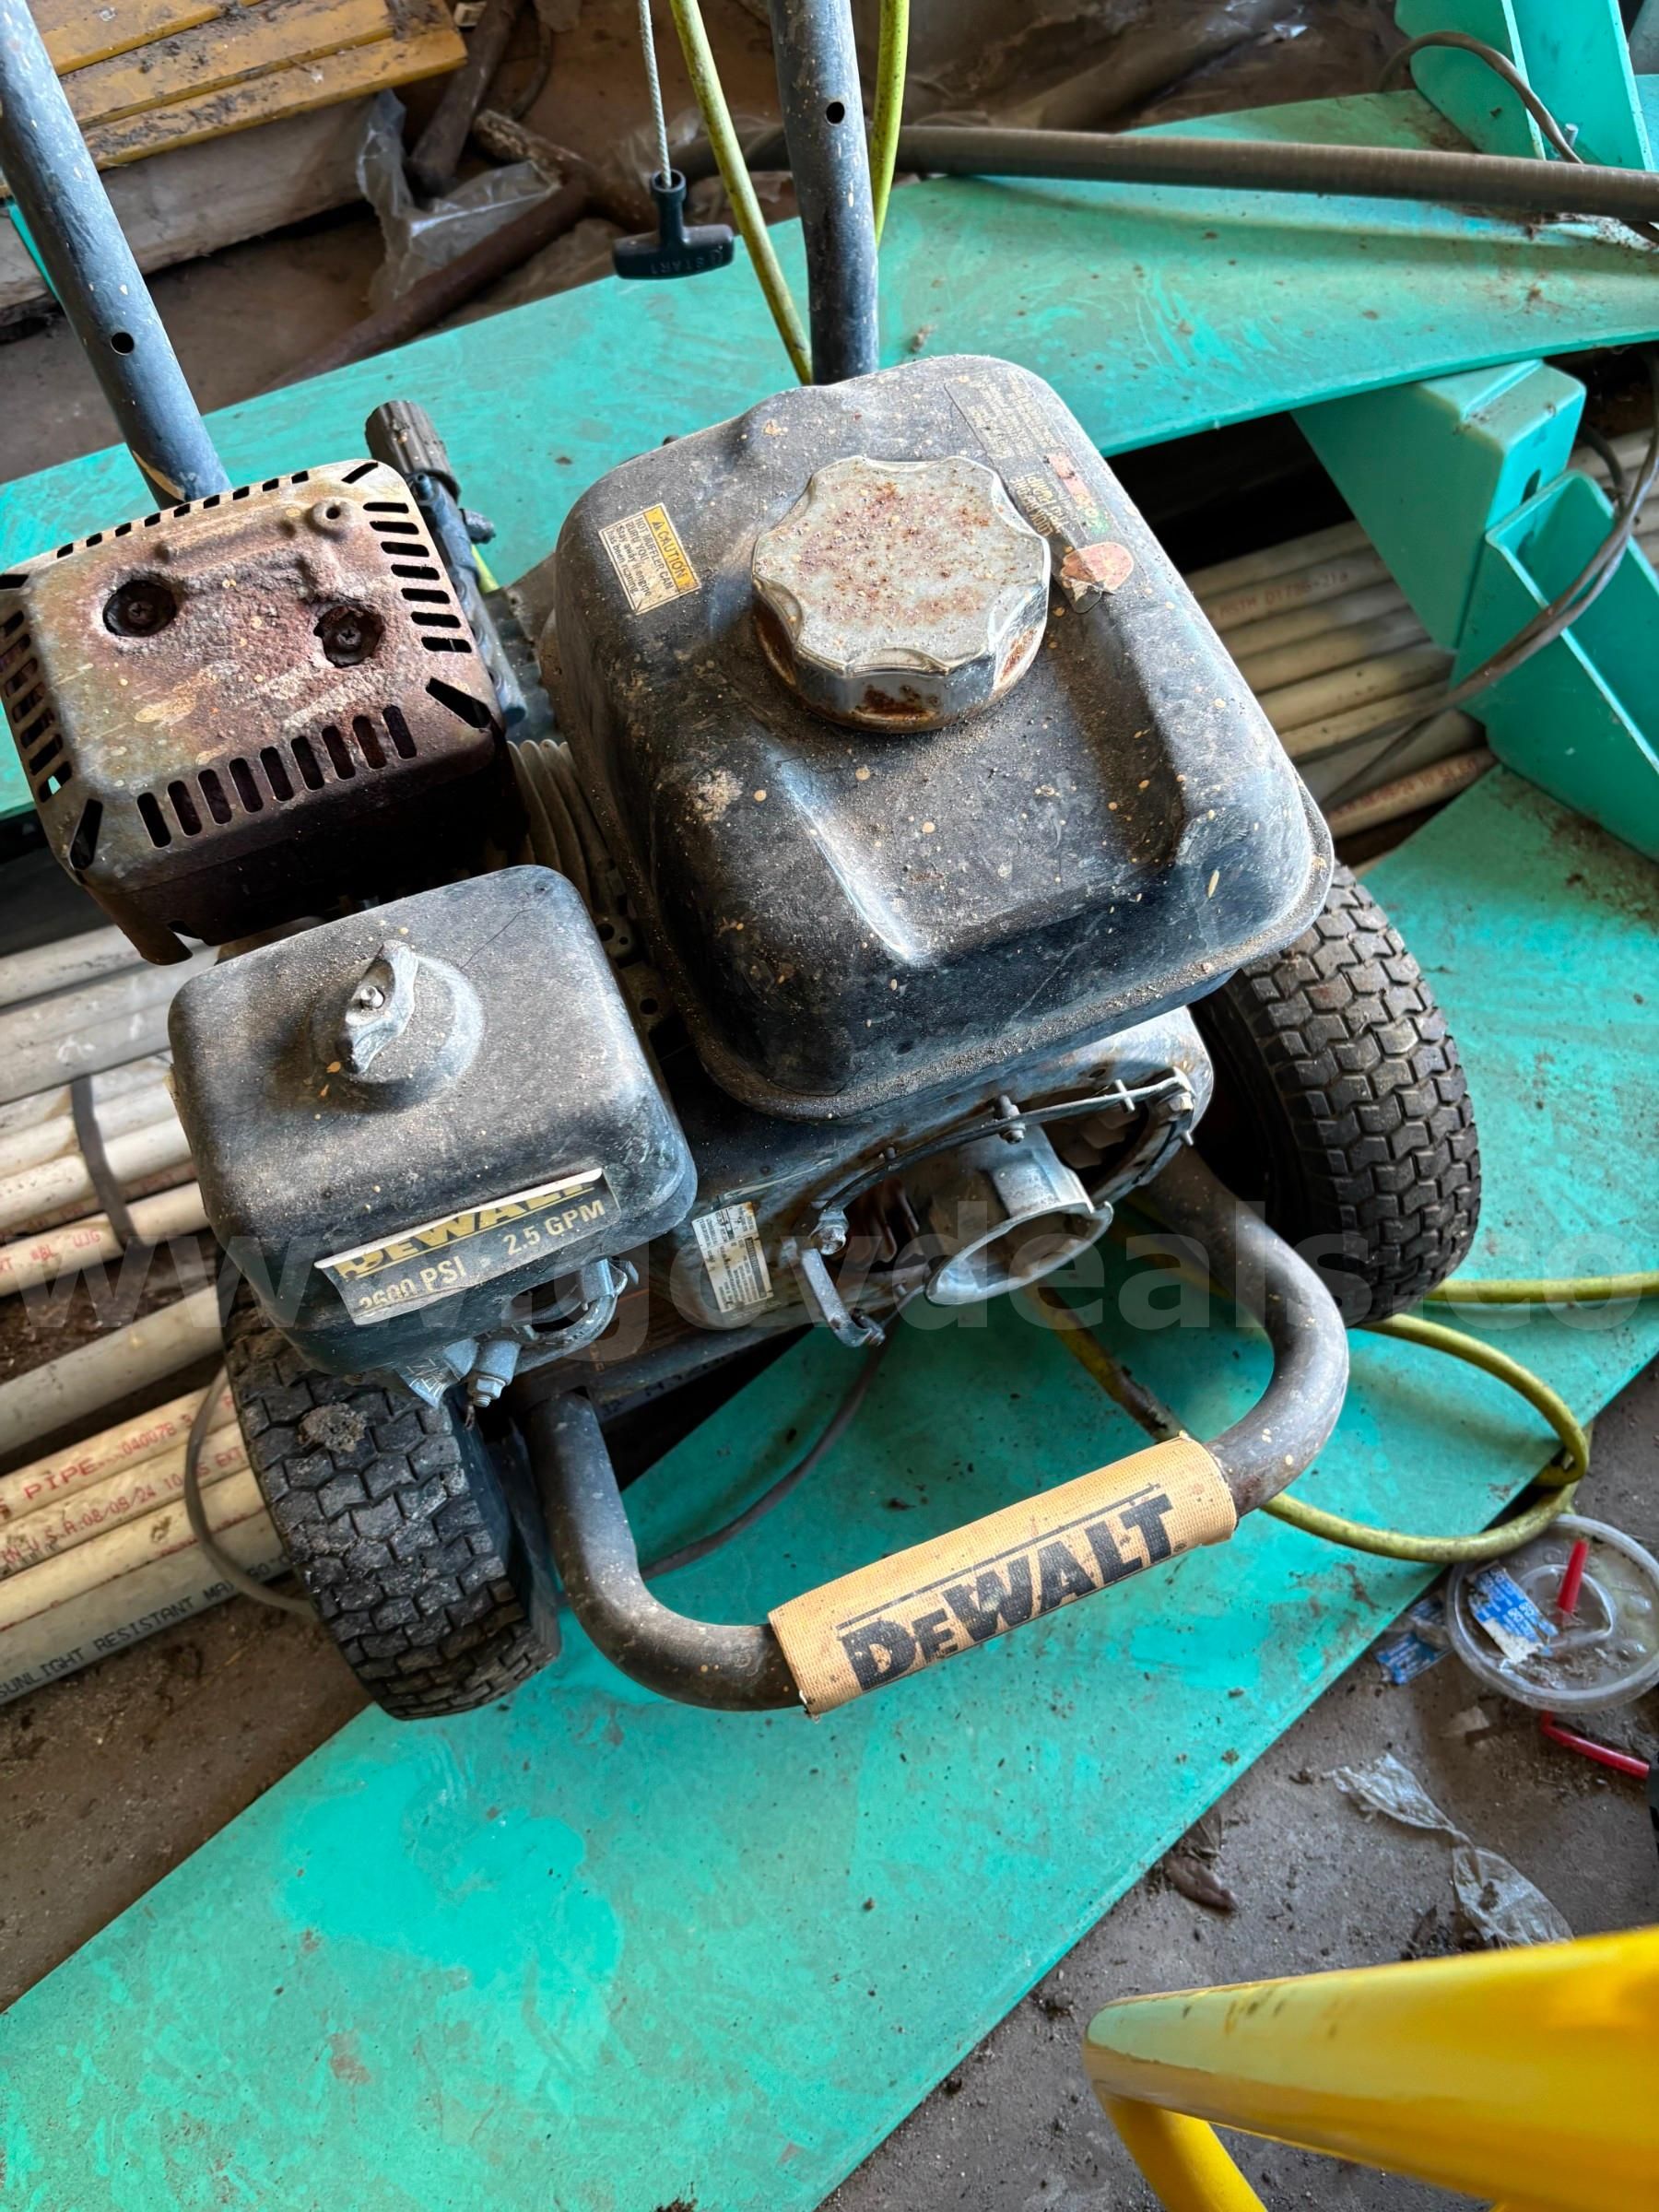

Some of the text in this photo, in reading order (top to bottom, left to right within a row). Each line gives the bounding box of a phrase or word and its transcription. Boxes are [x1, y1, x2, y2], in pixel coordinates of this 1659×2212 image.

[1010, 477, 1054, 537] LOOK BEFORE
[612, 544, 627, 563] been
[613, 525, 629, 543] Stay
[621, 543, 637, 563] away
[634, 571, 652, 597] engine
[635, 517, 674, 590] HOT MUFFLER CAN
[656, 529, 688, 579] CAUTION
[333, 1181, 595, 1279] DEWA
[420, 1255, 466, 1292] PSI
[502, 1226, 540, 1255] 2.5
[544, 1199, 606, 1236] GPM
[94, 1596, 194, 1652] RESISTANT
